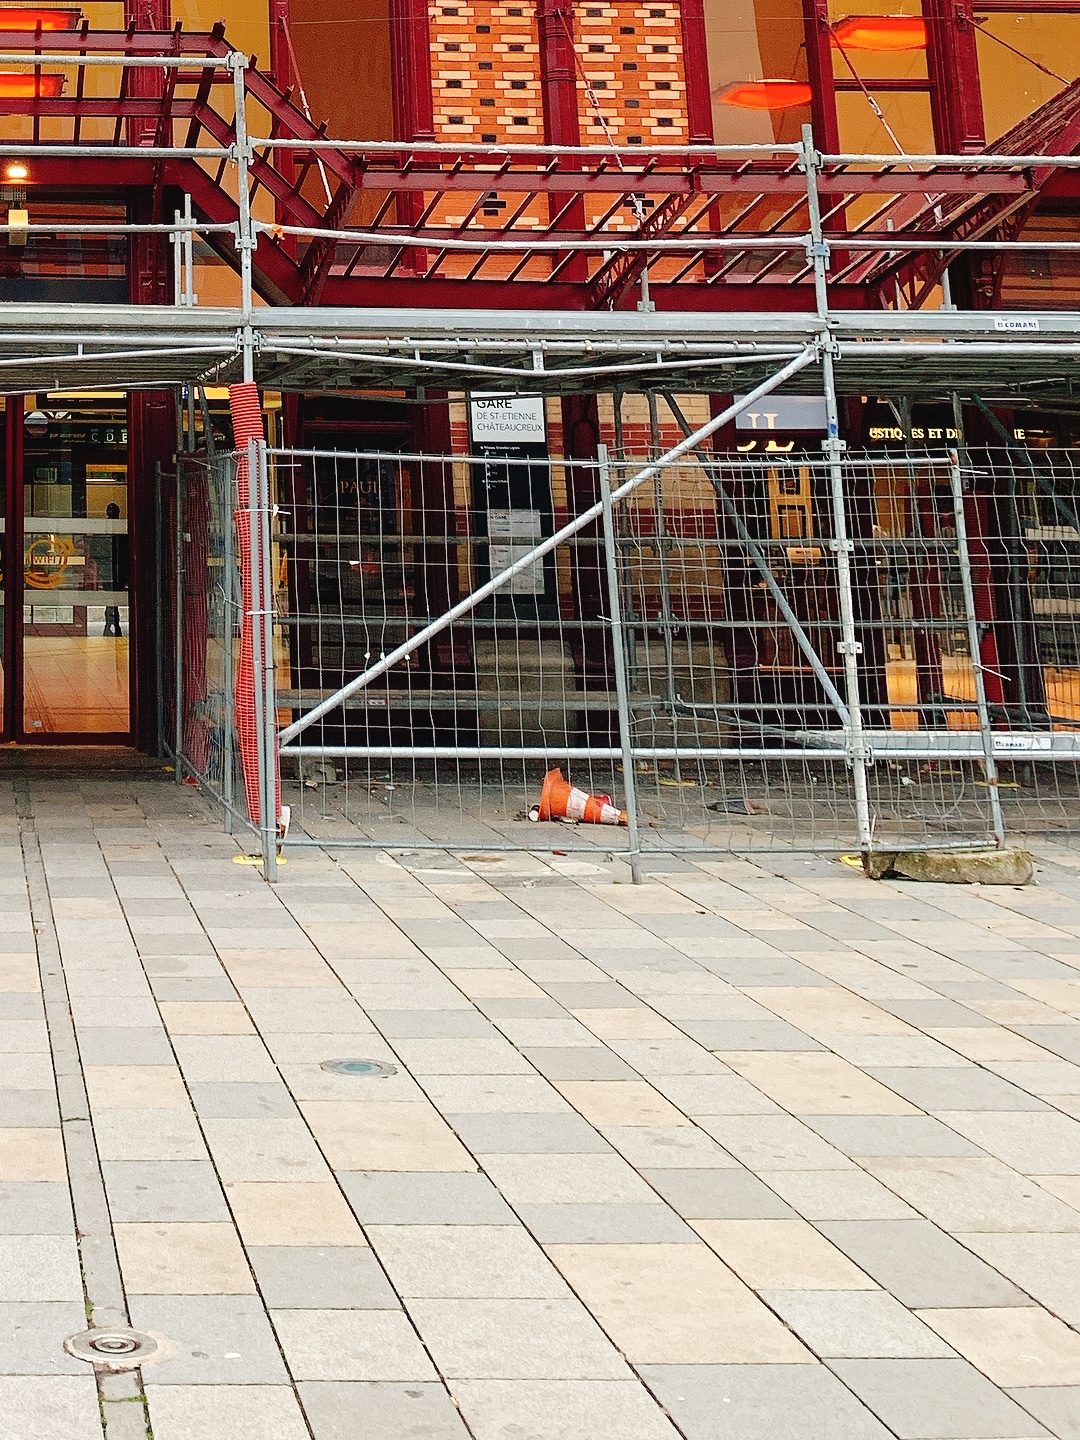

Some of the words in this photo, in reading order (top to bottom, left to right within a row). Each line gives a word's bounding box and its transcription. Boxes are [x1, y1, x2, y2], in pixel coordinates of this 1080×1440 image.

[476, 400, 513, 409] GARE
[476, 412, 488, 420] DE
[927, 428, 944, 439] ET
